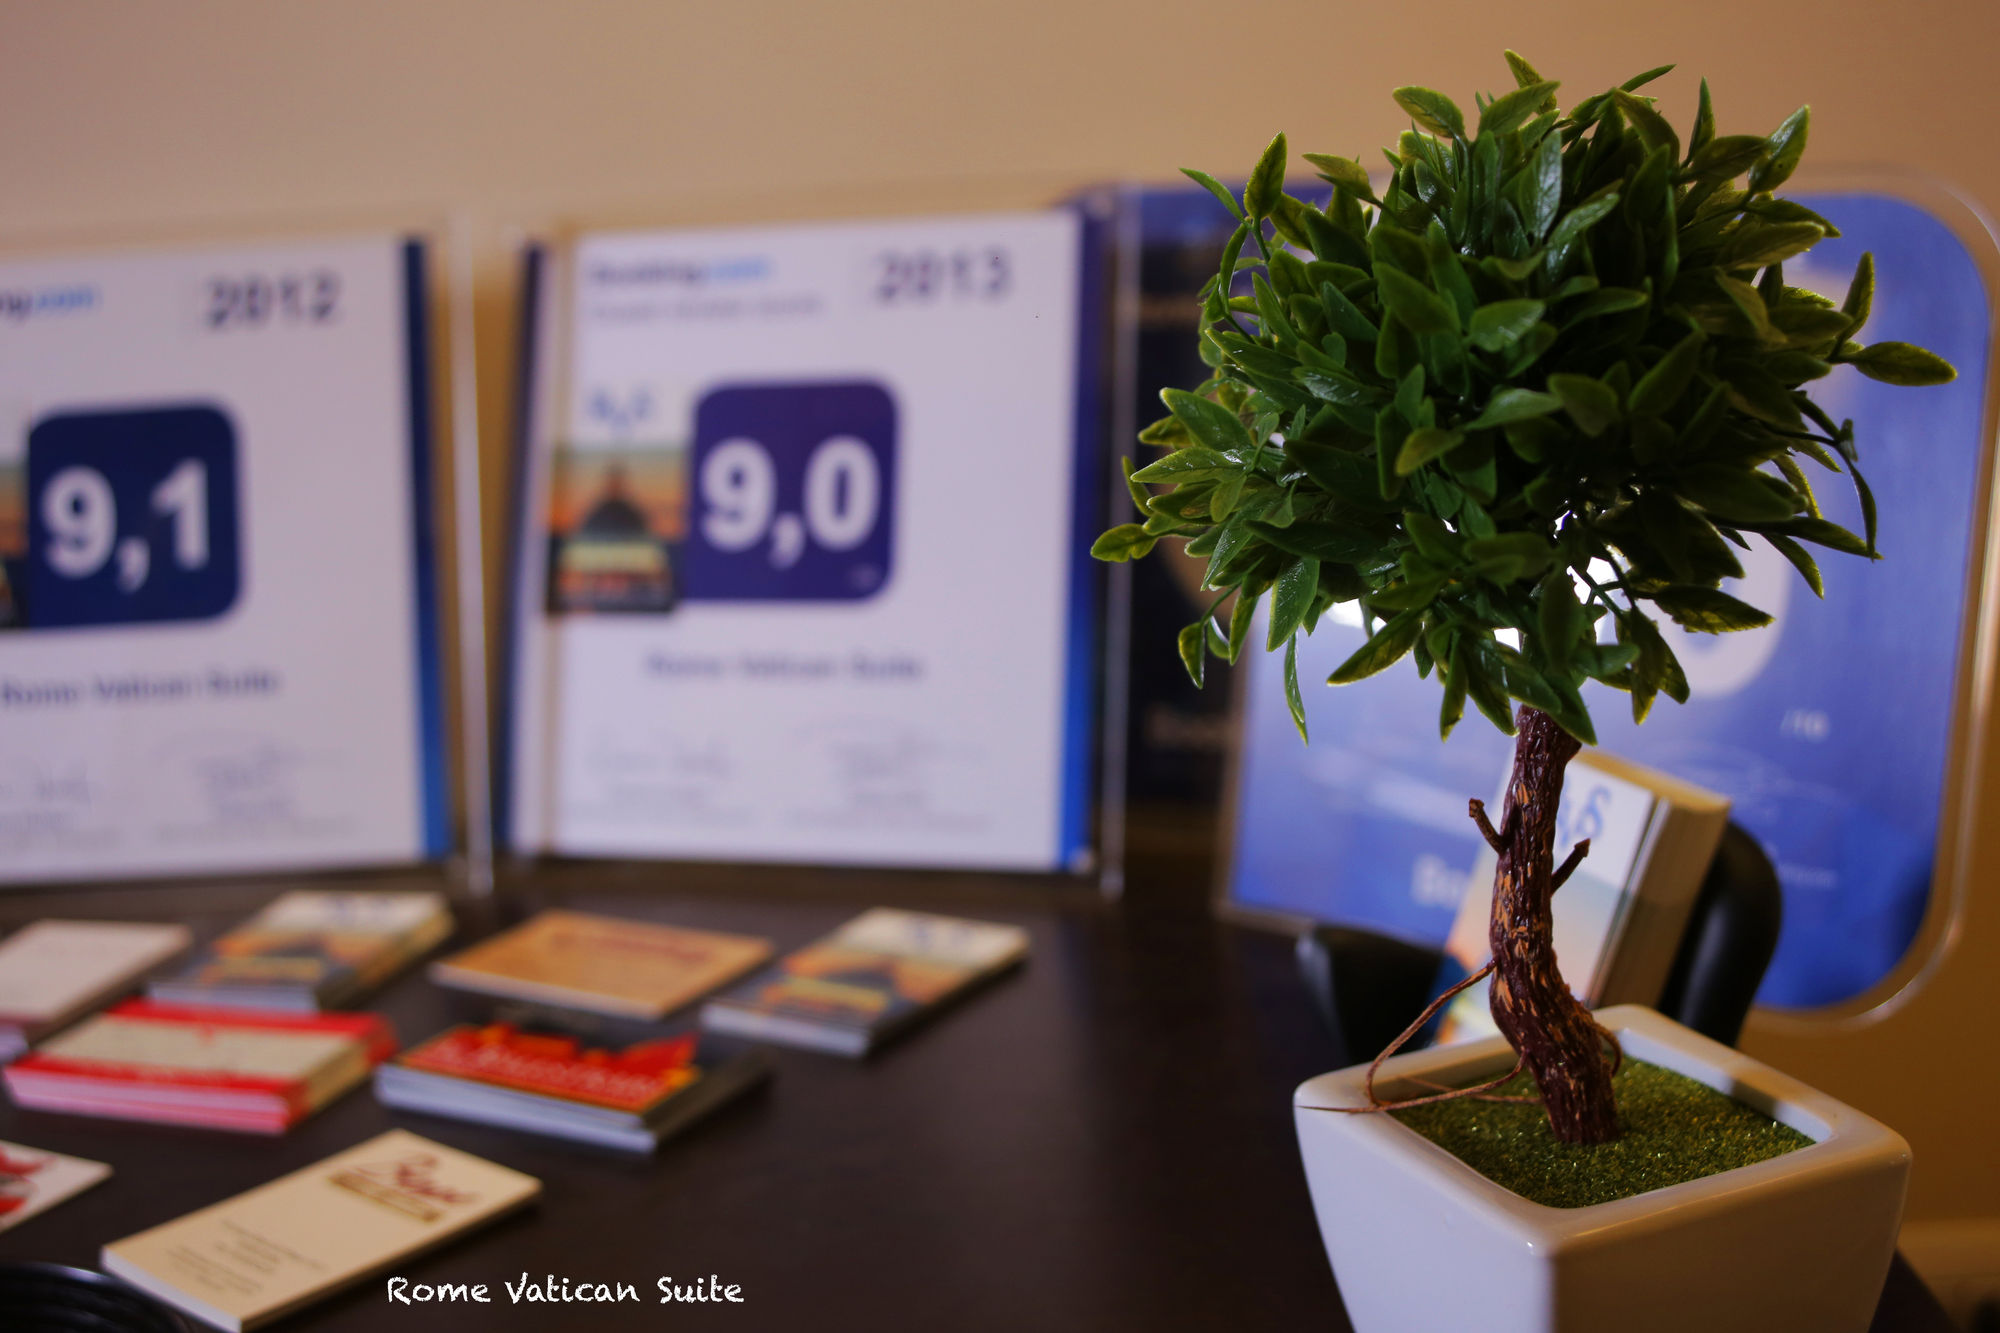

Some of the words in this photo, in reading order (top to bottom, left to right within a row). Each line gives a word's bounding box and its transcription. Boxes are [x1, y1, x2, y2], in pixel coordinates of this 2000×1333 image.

[203, 270, 343, 328] 2012
[41, 458, 209, 591] 9,1
[703, 434, 882, 568] 9,0
